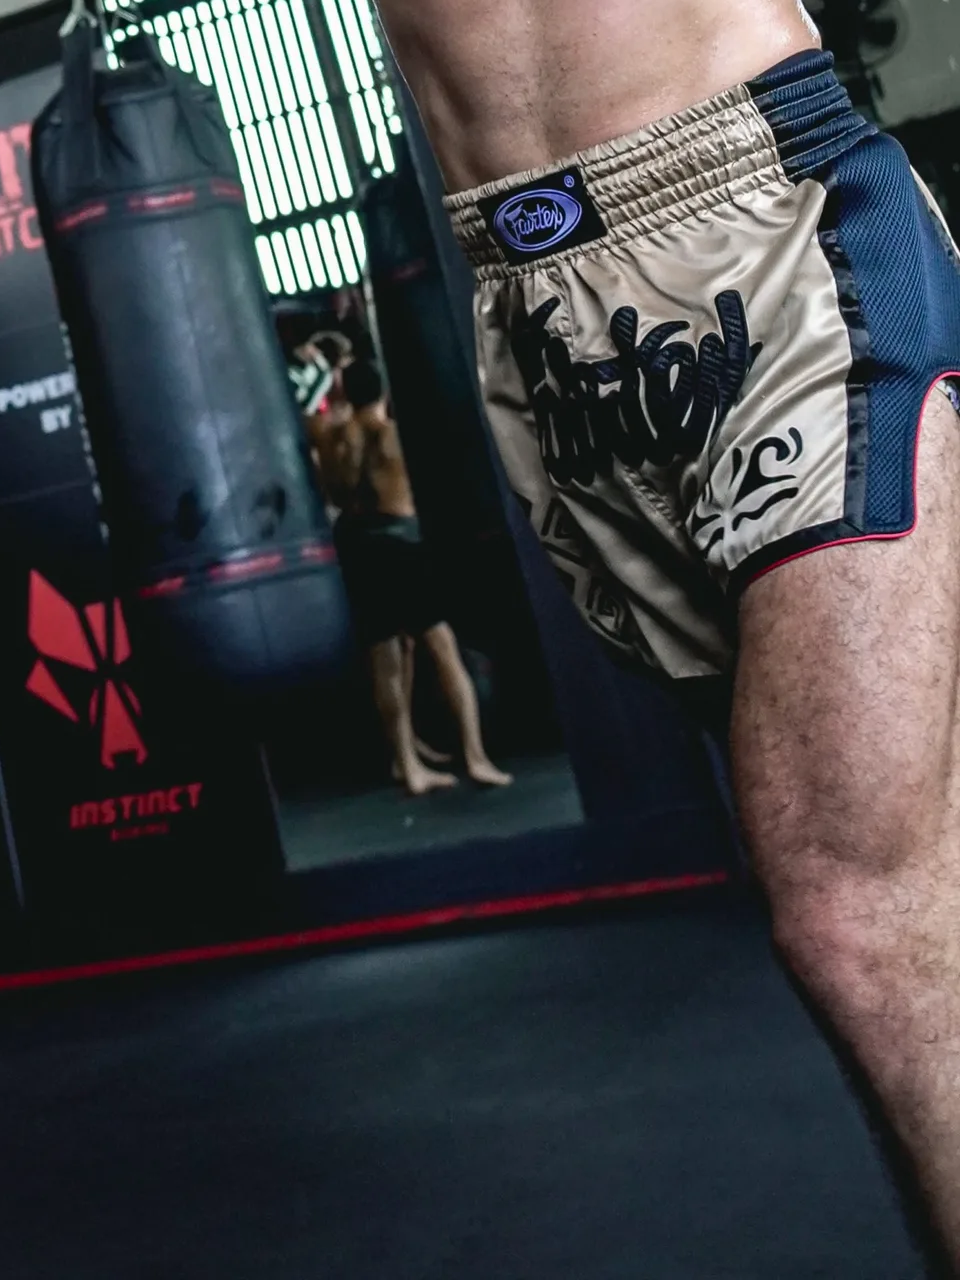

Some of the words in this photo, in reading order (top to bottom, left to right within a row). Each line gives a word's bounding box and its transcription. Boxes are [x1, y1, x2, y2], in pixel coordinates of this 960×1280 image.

[504, 201, 564, 241] Fairtex
[40, 404, 72, 434] BY
[69, 782, 203, 829] INSTINCT
